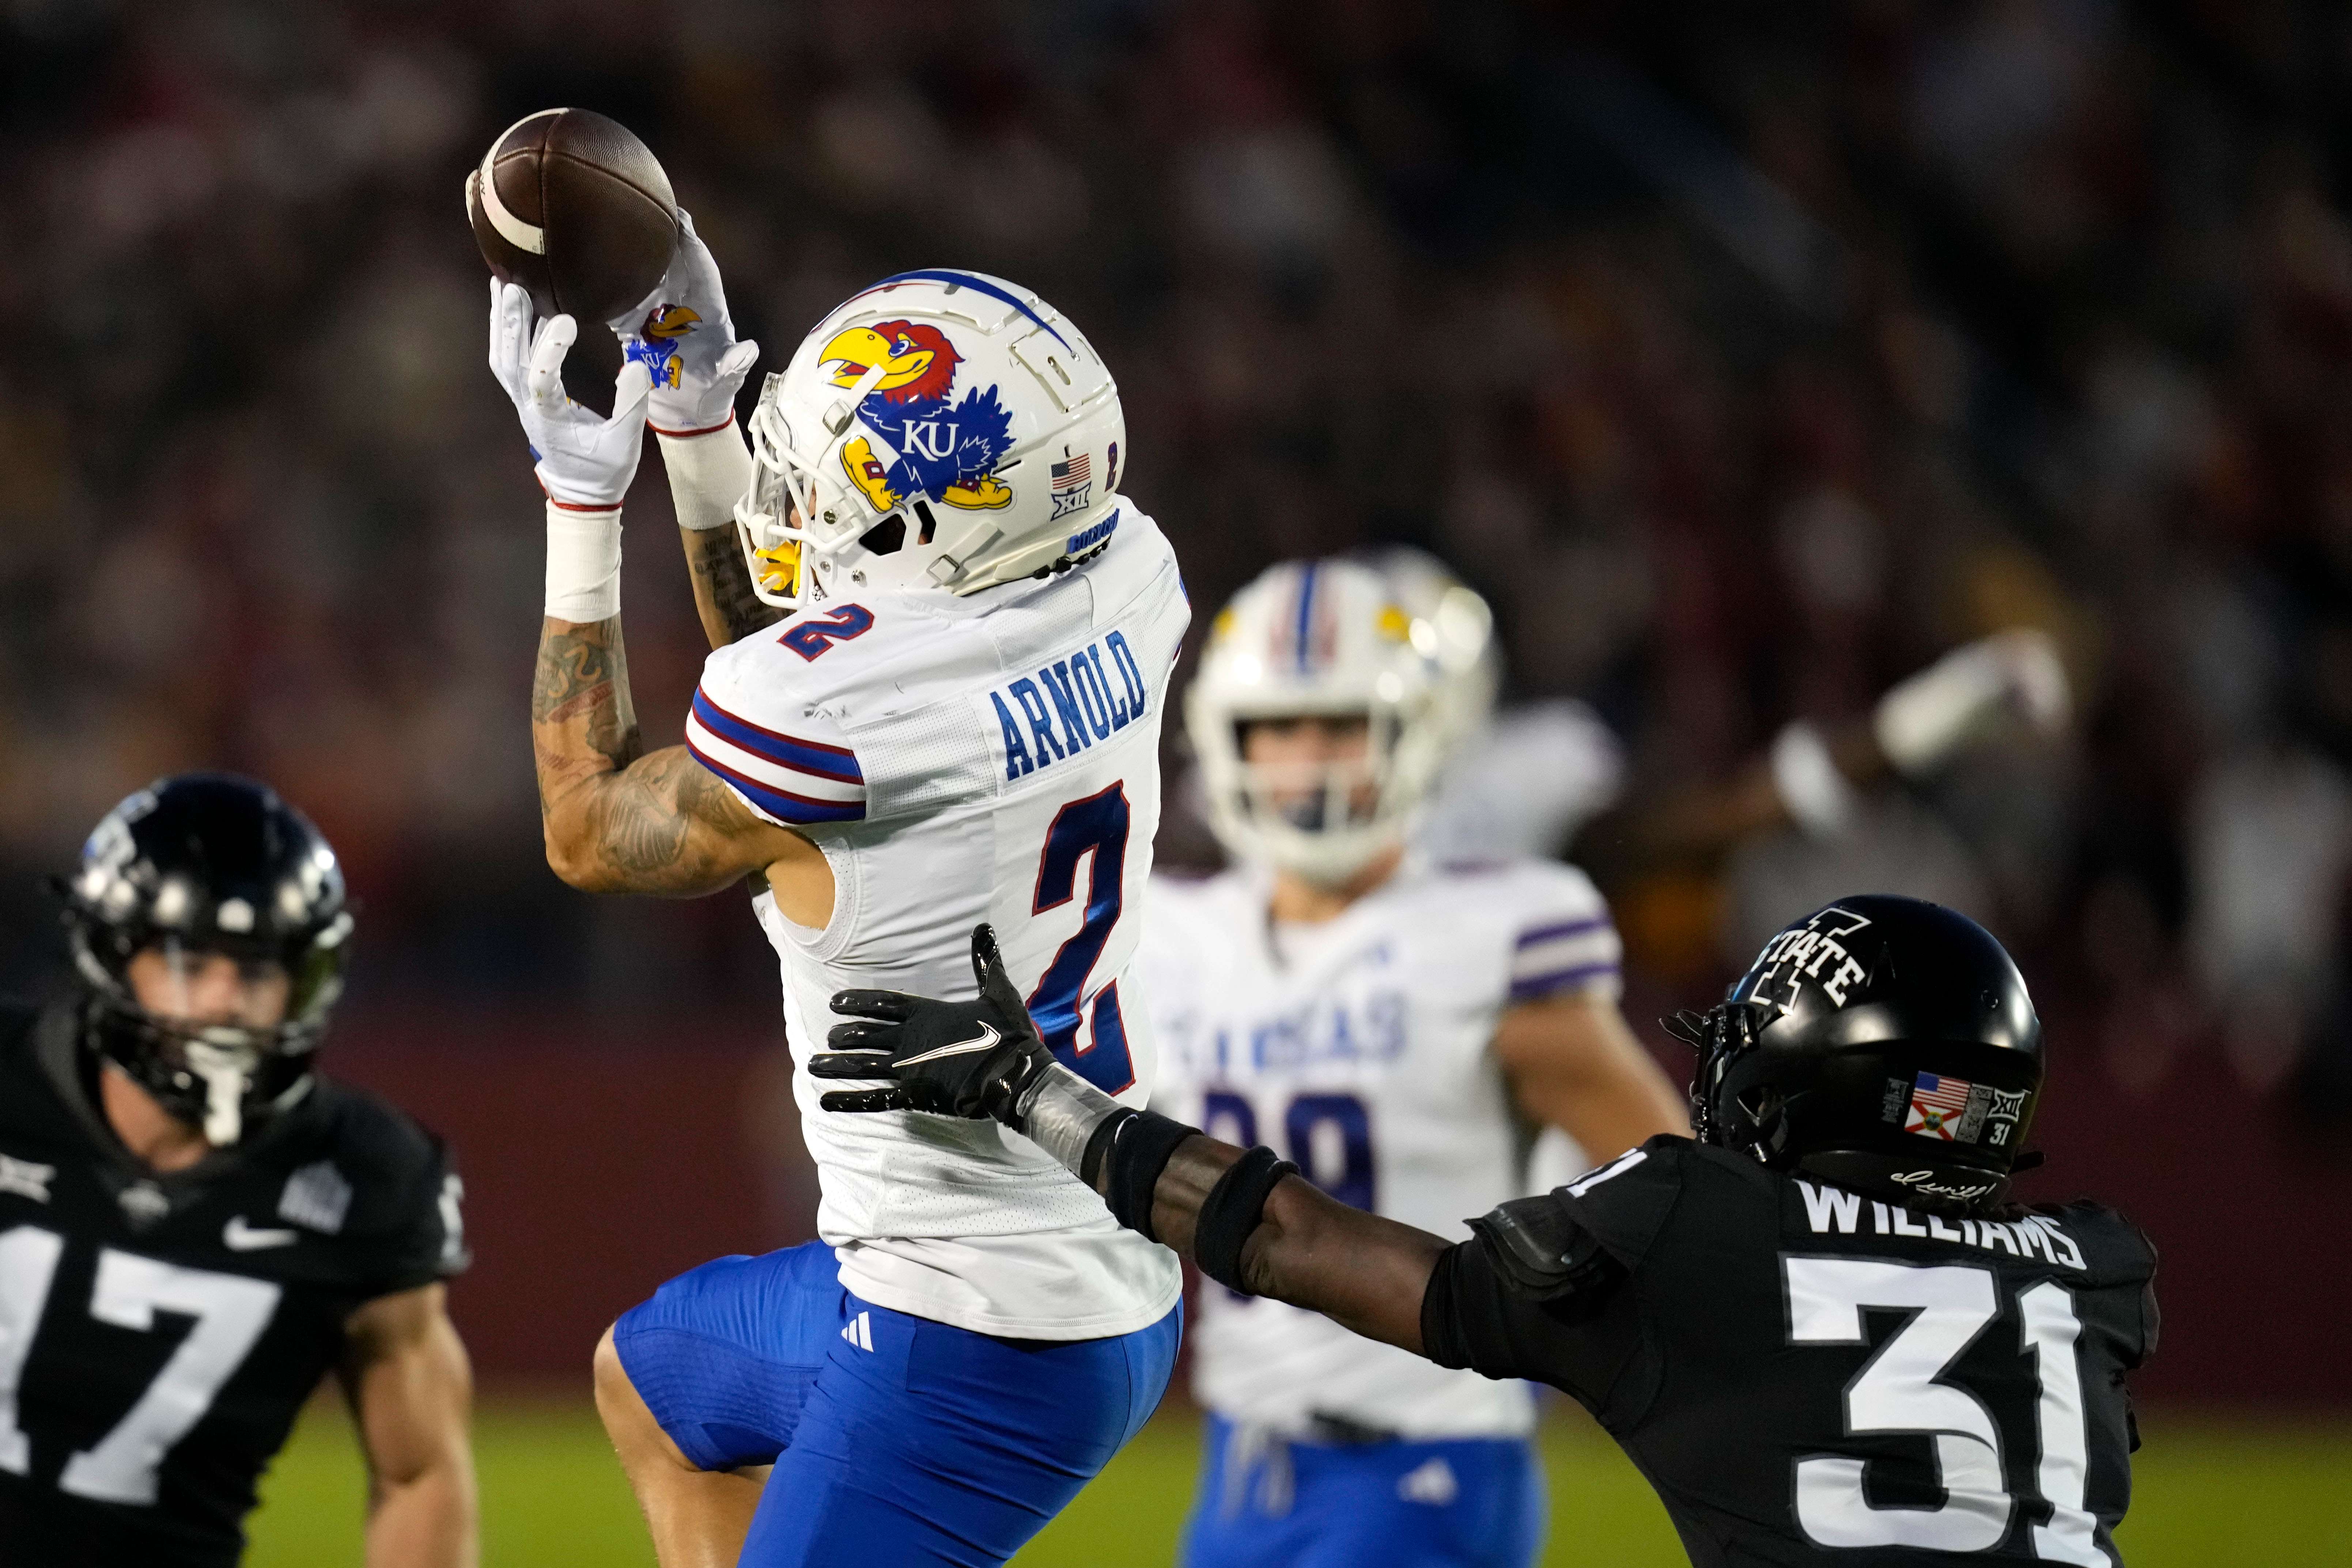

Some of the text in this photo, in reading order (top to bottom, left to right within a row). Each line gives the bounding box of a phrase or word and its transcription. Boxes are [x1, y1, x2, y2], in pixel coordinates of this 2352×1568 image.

[640, 352, 660, 370] KU
[901, 419, 960, 462] KU
[1104, 440, 1118, 493] 2
[775, 602, 876, 663] 2
[990, 629, 1147, 782] ARNOLD
[1024, 778, 1136, 1098] 2
[1989, 1122, 2011, 1146] 31
[1792, 1178, 2087, 1270] WILLIAMS
[0, 1223, 284, 1507] 17
[1785, 1257, 2112, 1568] 31
